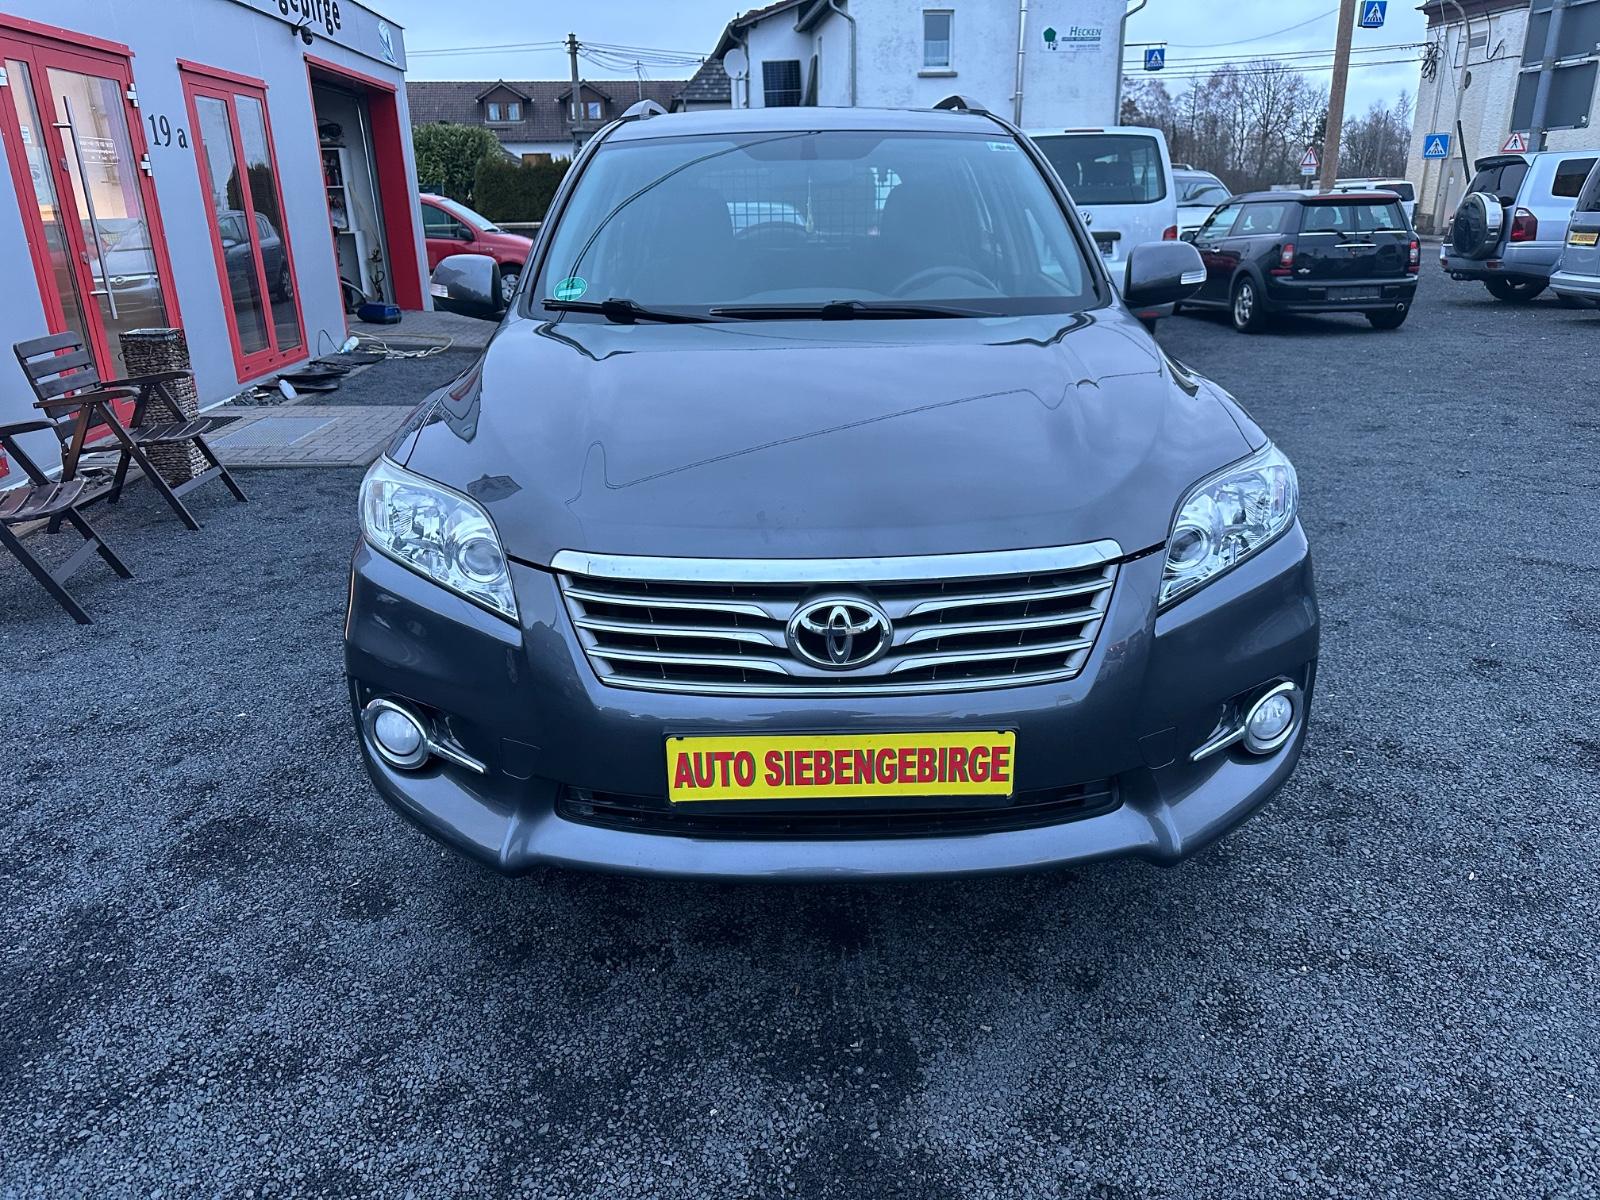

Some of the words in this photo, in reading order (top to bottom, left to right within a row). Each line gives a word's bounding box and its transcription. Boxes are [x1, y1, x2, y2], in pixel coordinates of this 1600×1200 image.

[148, 114, 172, 147] 19
[177, 128, 188, 148] a
[674, 751, 756, 788] AUTO
[764, 746, 1011, 786] SIEBENGEBIRGE
